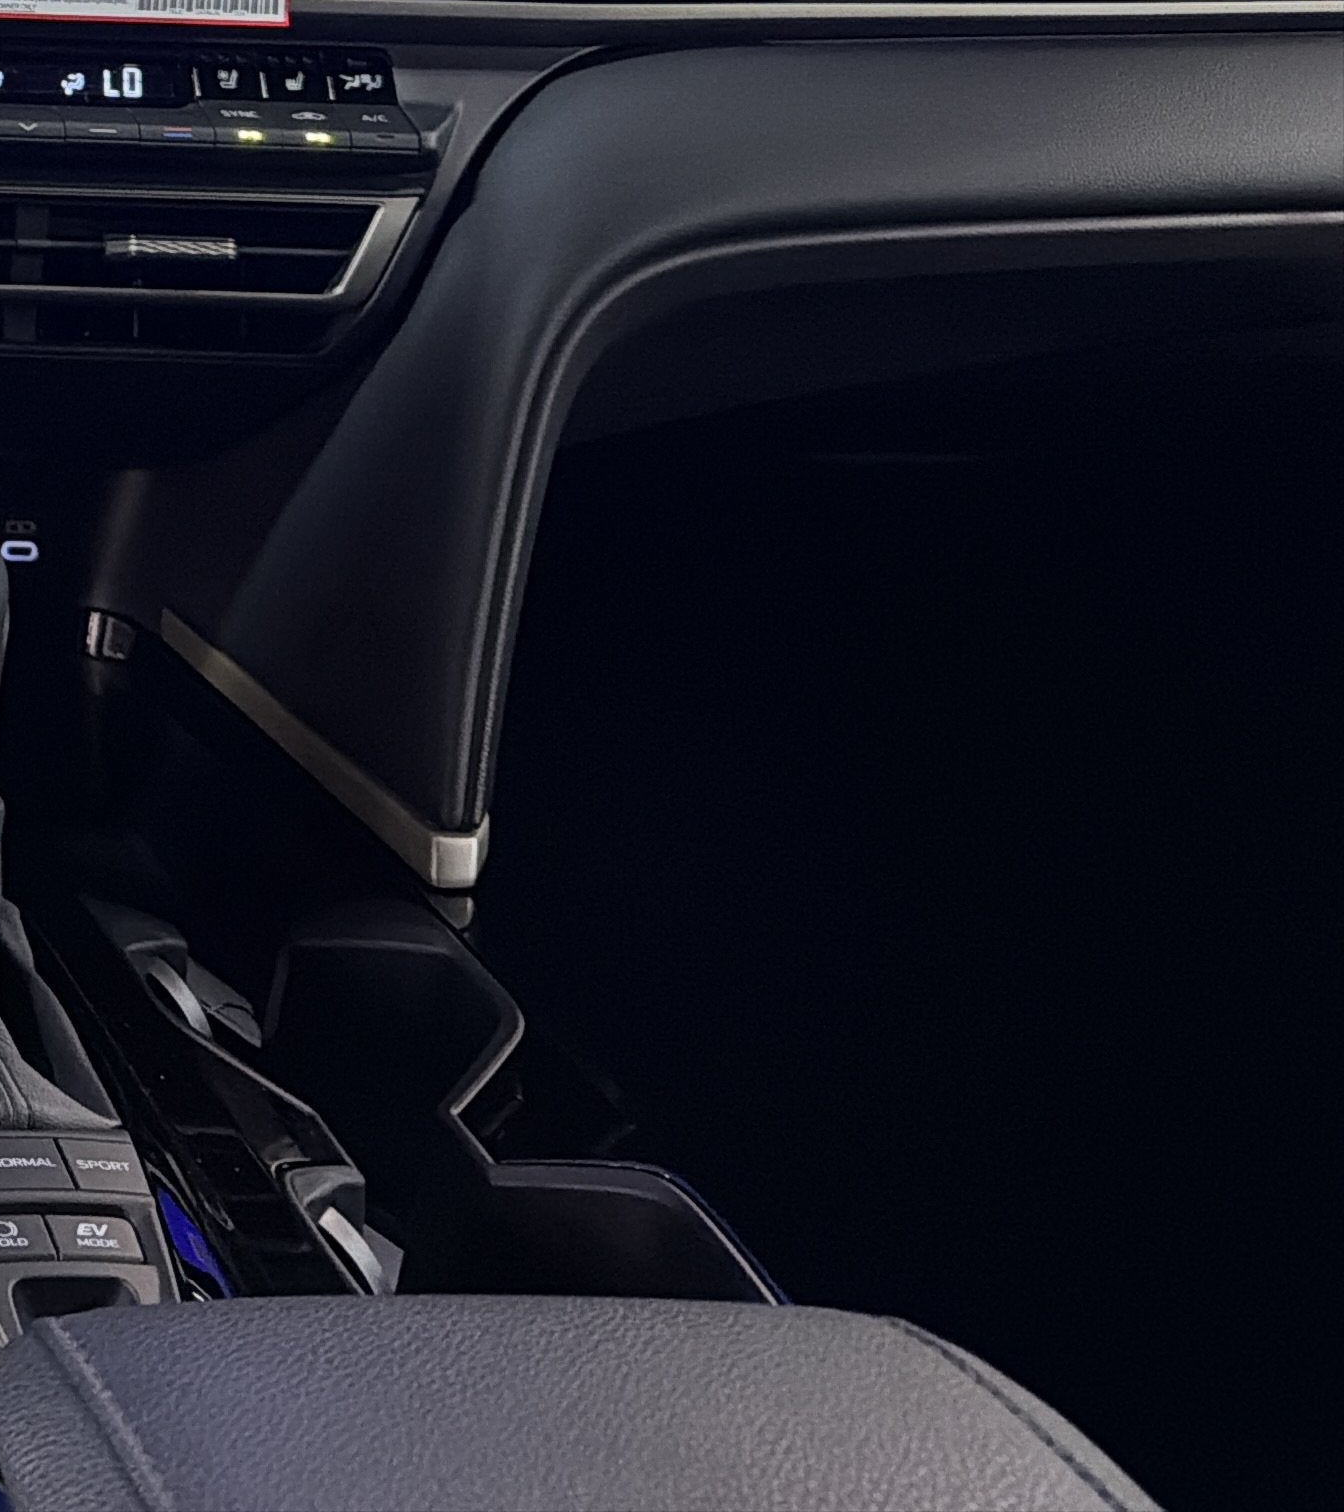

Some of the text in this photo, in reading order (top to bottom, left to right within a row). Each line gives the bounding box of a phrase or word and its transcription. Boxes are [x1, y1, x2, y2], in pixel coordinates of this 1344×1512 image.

[102, 66, 143, 98] LO
[219, 109, 262, 119] SYNC
[361, 114, 389, 123] A/C
[76, 1159, 131, 1172] SPORT
[76, 1223, 108, 1237] EV
[77, 1237, 120, 1249] MODE
